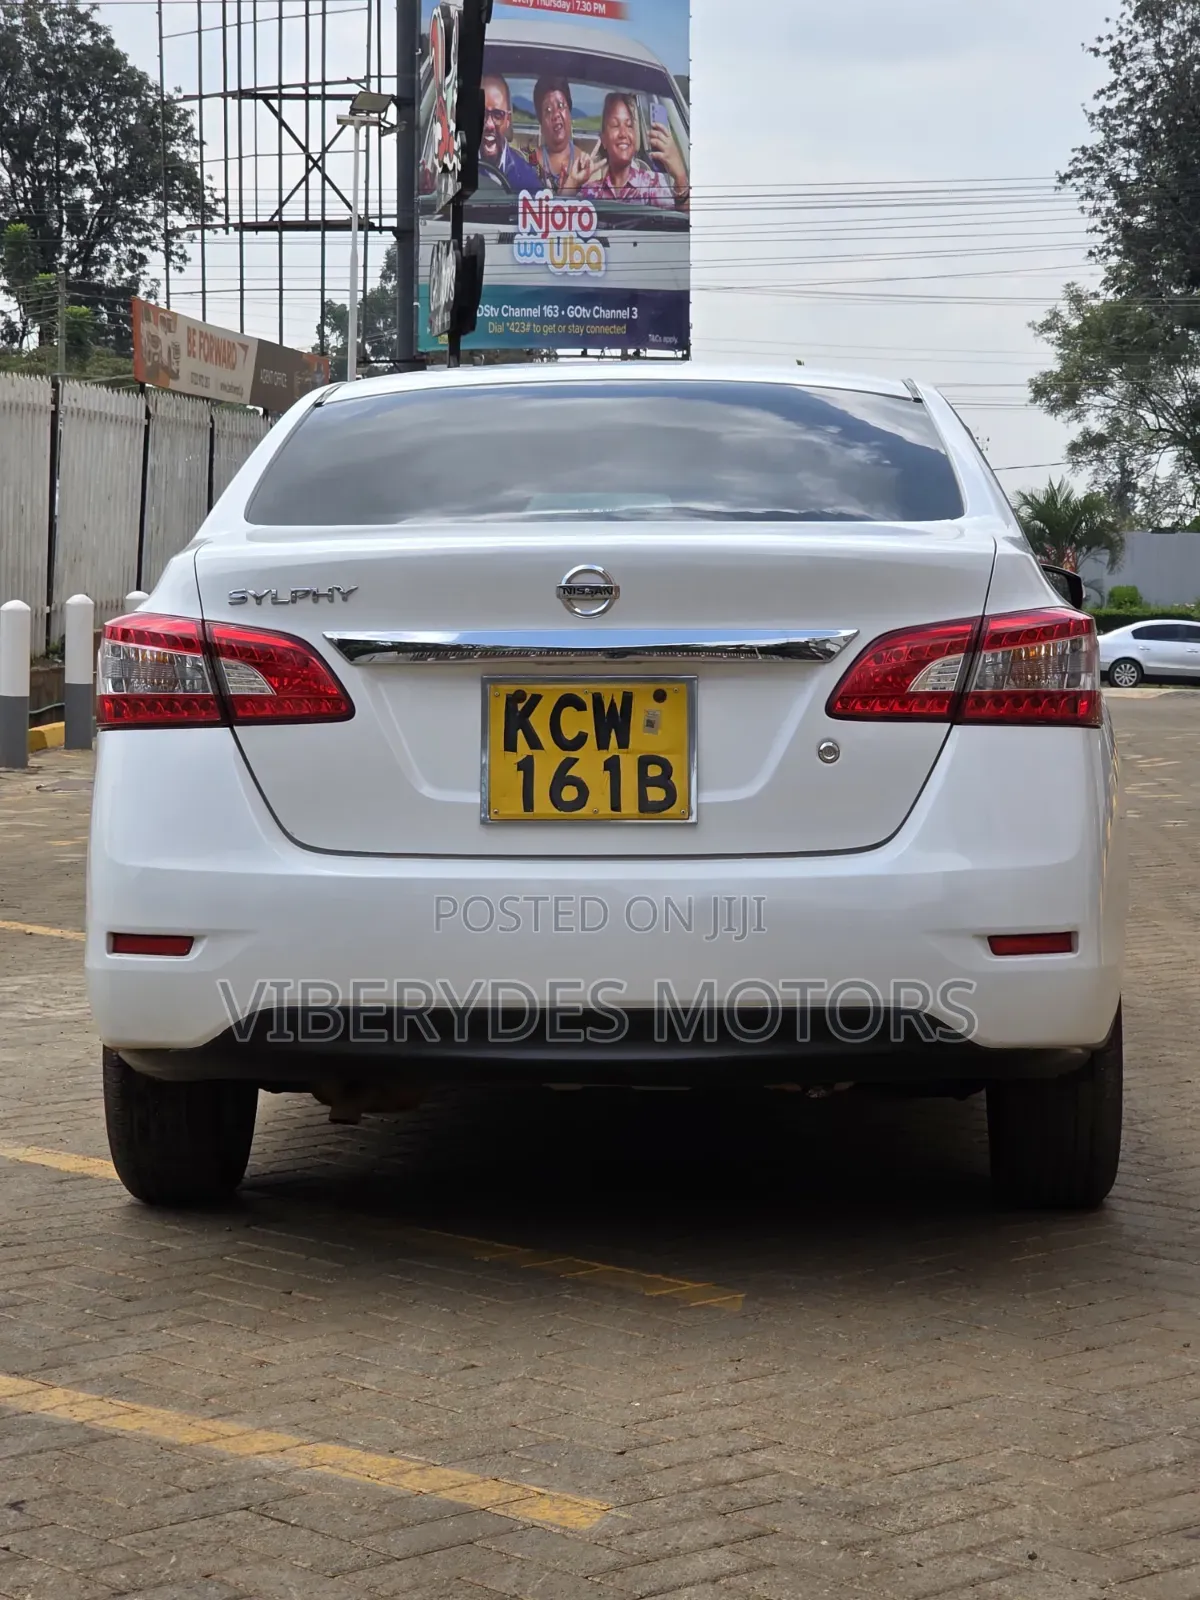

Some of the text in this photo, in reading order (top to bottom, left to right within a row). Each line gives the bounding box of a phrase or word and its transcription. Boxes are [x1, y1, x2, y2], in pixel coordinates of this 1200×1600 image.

[576, 1, 592, 12] 7.30
[593, 3, 606, 14] PM
[522, 195, 594, 239] Njoro
[517, 234, 603, 271] wa Uba
[477, 304, 639, 319] DStv Channel 163 GOtv Channel 3
[488, 321, 505, 333] Dial
[533, 322, 541, 333] to
[542, 323, 556, 336] get
[558, 325, 567, 333] or
[567, 322, 584, 336] stay
[586, 323, 627, 334] connected
[186, 326, 238, 371] BE FORWARD
[228, 584, 359, 606] SYLPHY
[562, 586, 613, 596] NISSAN
[504, 691, 633, 752] KCW
[516, 754, 677, 814] 161B
